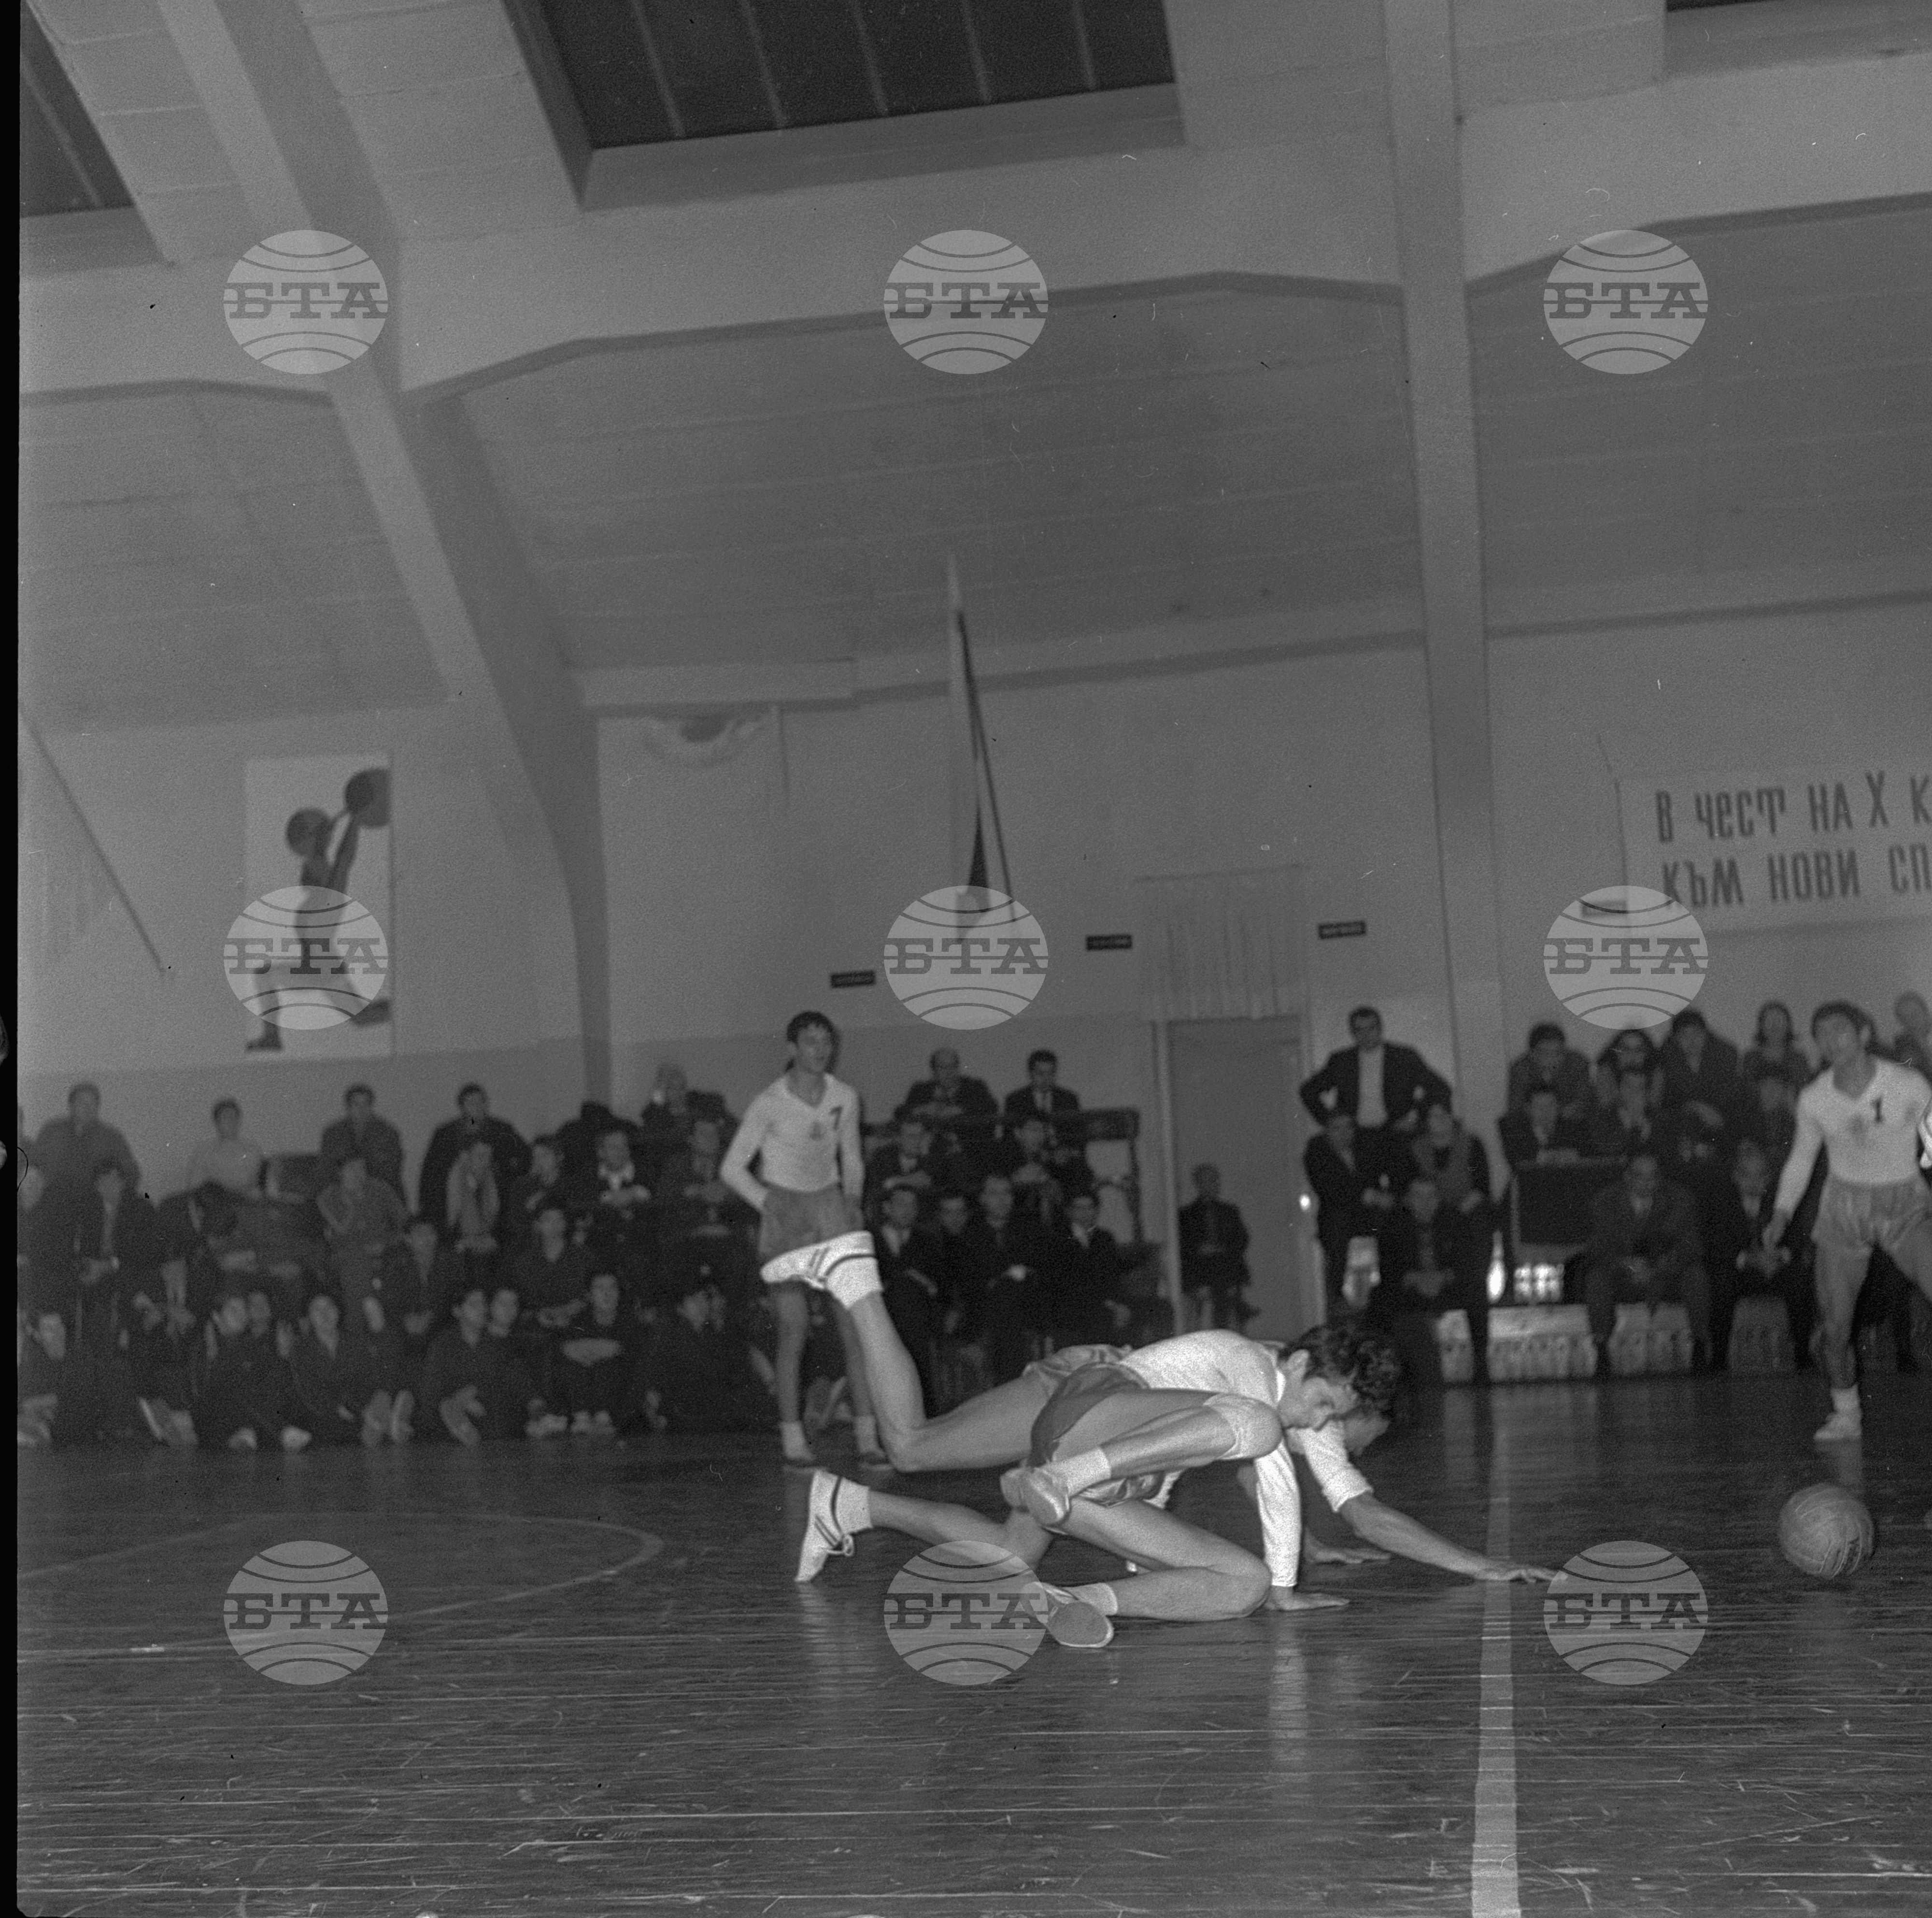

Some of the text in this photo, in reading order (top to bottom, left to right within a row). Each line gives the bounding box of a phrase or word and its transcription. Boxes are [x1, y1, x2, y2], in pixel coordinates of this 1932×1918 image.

[1656, 790, 1674, 843] В
[1695, 787, 1785, 839] ЧЕСТ
[1808, 782, 1853, 832] НА
[1662, 842, 1931, 909] КЪМ НОВИ СП
[830, 1105, 843, 1131] 7
[1871, 1097, 1883, 1125] 1
